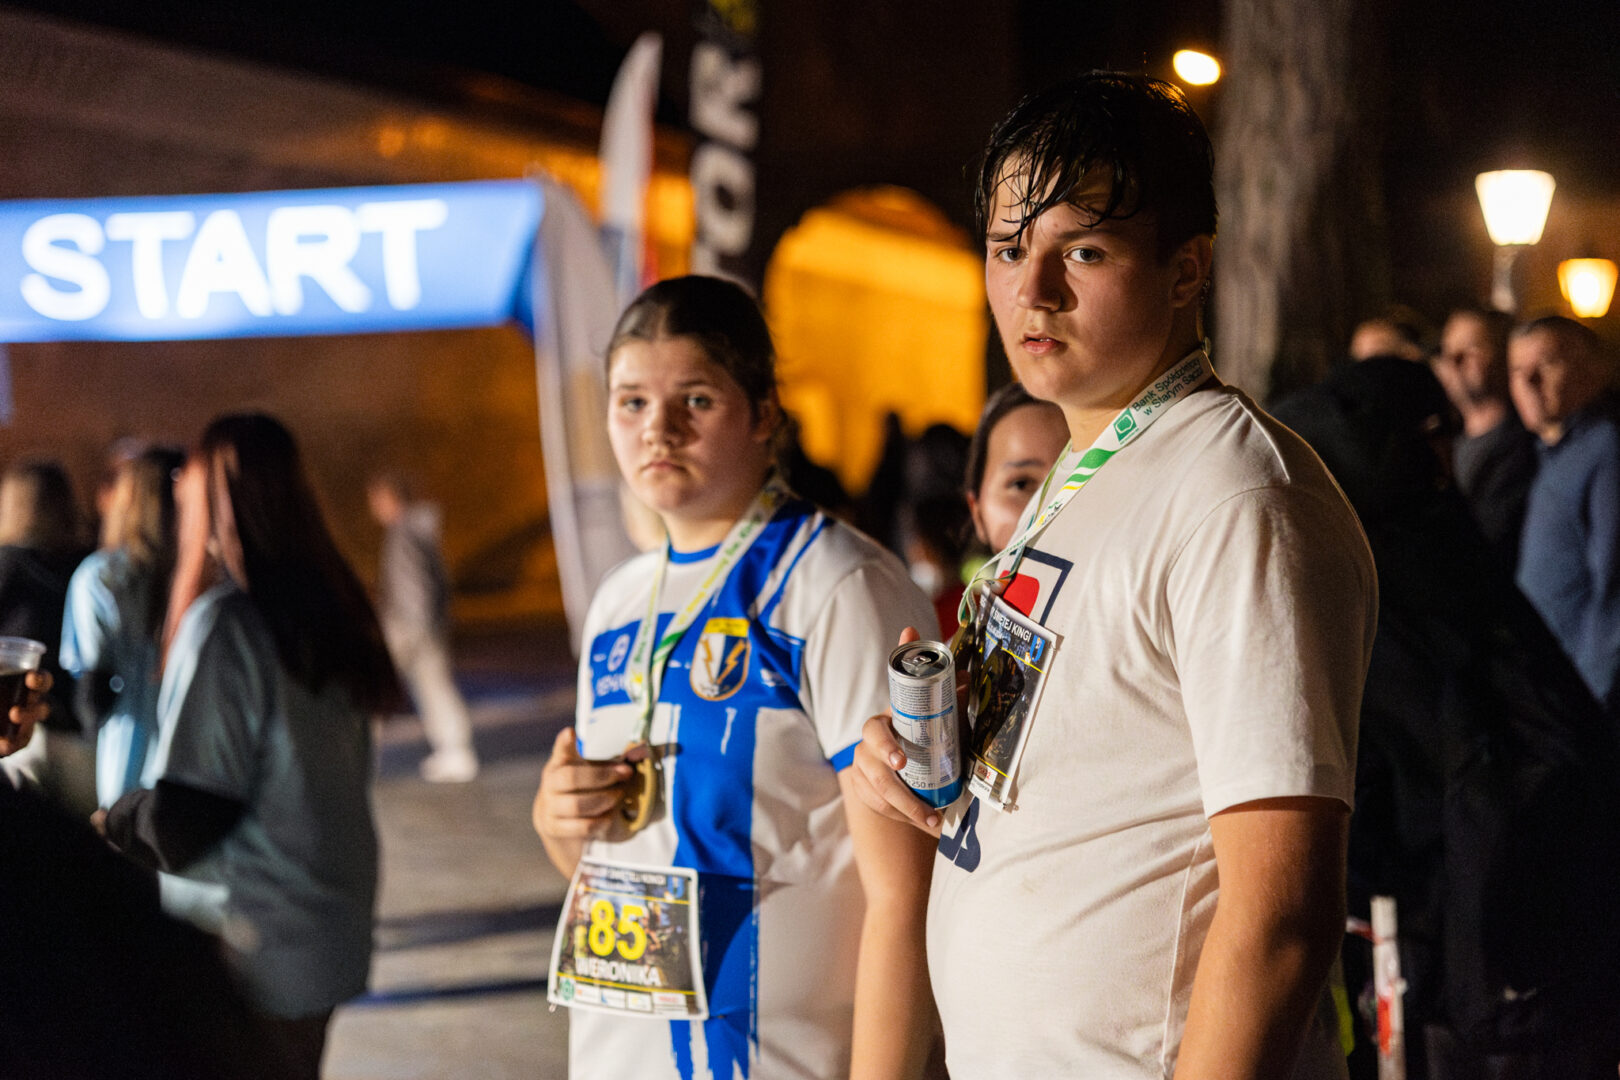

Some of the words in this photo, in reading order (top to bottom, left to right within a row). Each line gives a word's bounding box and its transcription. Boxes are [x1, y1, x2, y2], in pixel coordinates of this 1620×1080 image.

[20, 199, 449, 321] START
[1132, 389, 1157, 412] Bank
[1143, 406, 1153, 416] w
[1151, 382, 1184, 408] Starym
[1011, 621, 1033, 643] KINGI
[911, 781, 926, 789] 250
[588, 899, 648, 961] 85
[574, 956, 662, 987] WERONIKA
